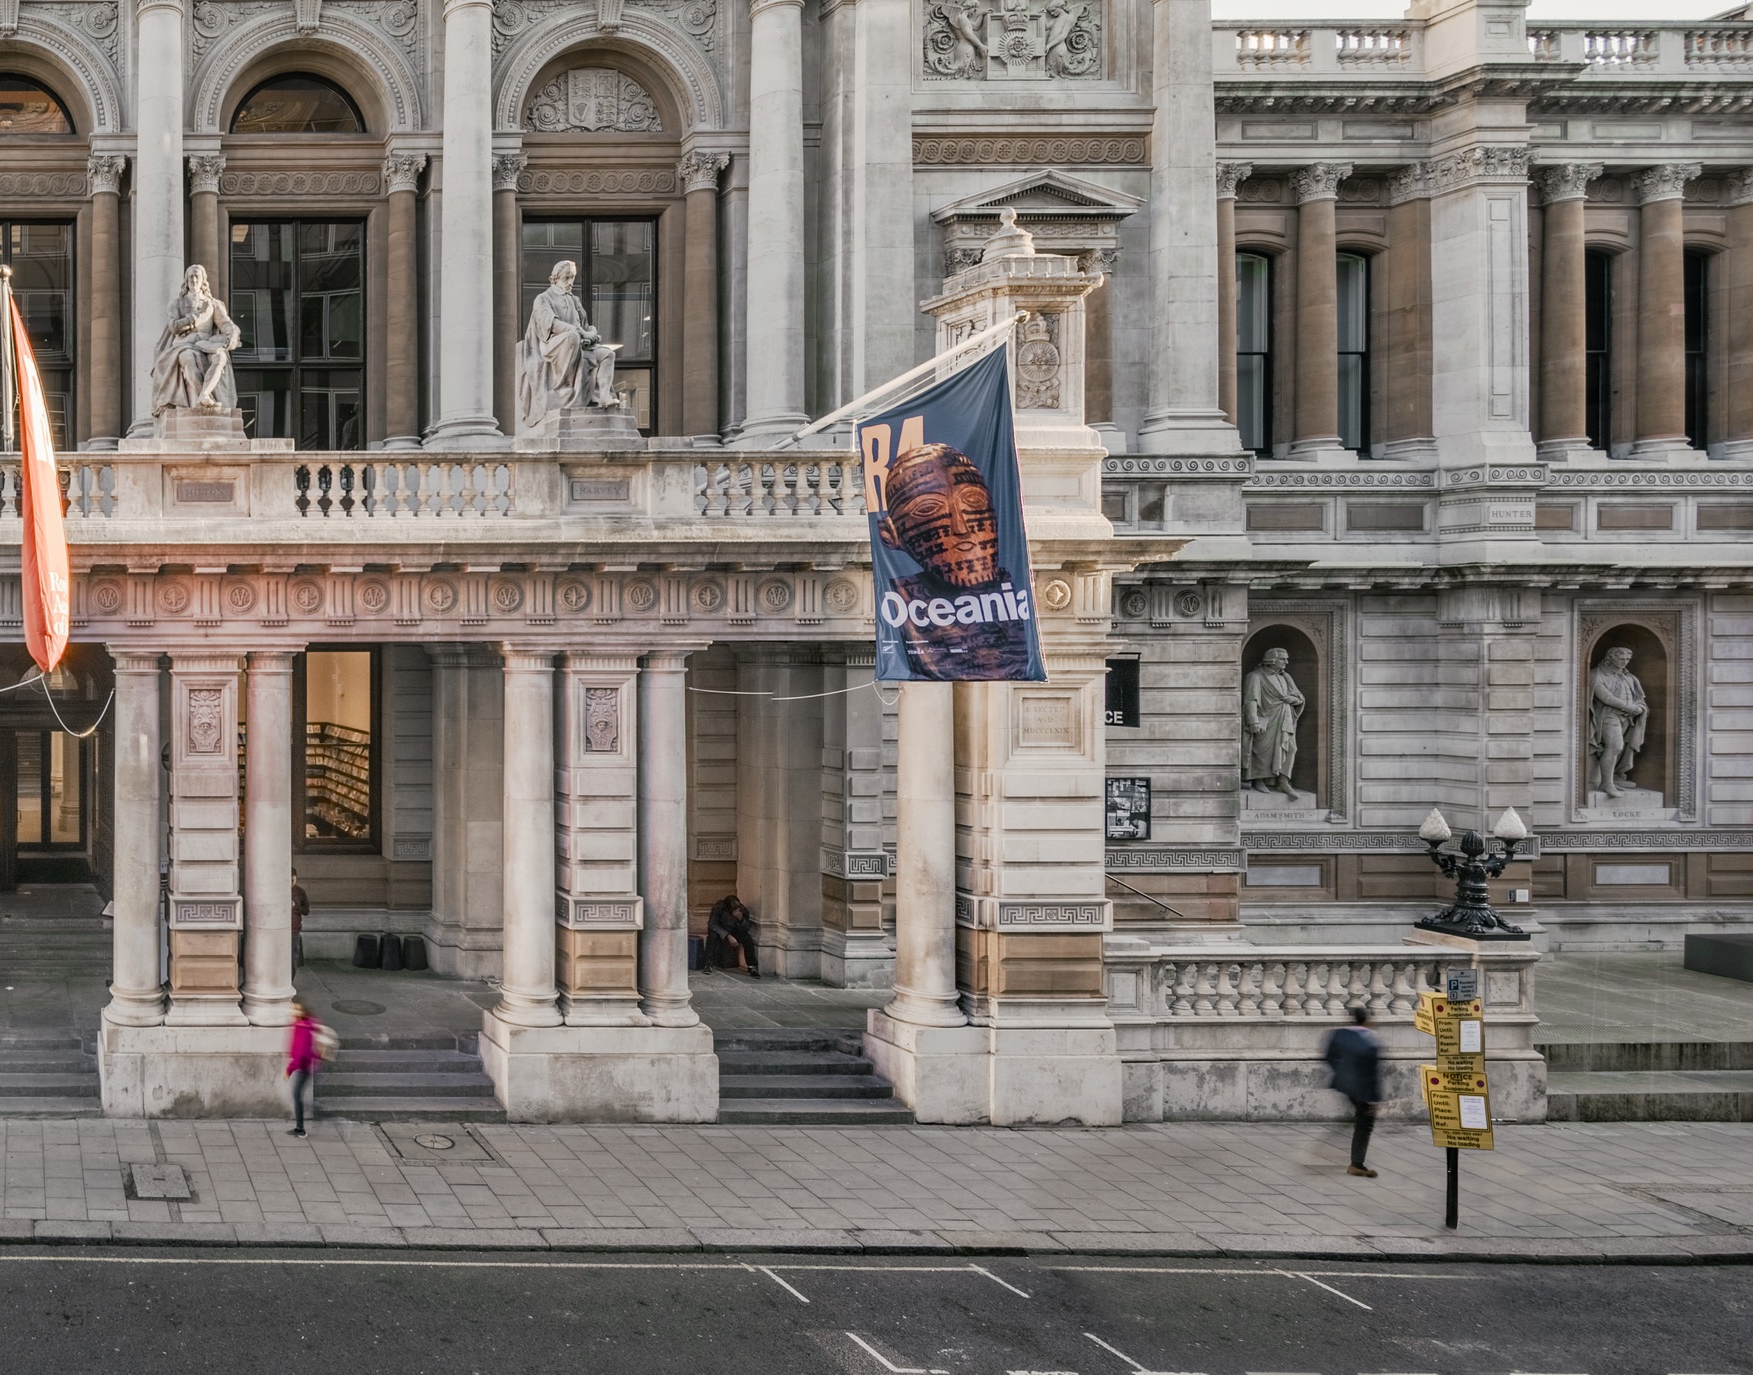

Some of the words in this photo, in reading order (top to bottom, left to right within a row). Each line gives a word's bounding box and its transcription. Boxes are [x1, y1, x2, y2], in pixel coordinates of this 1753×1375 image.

[579, 487, 621, 495] HARVEY
[1492, 510, 1532, 518] HUNTER
[881, 582, 1031, 628] Oceania
